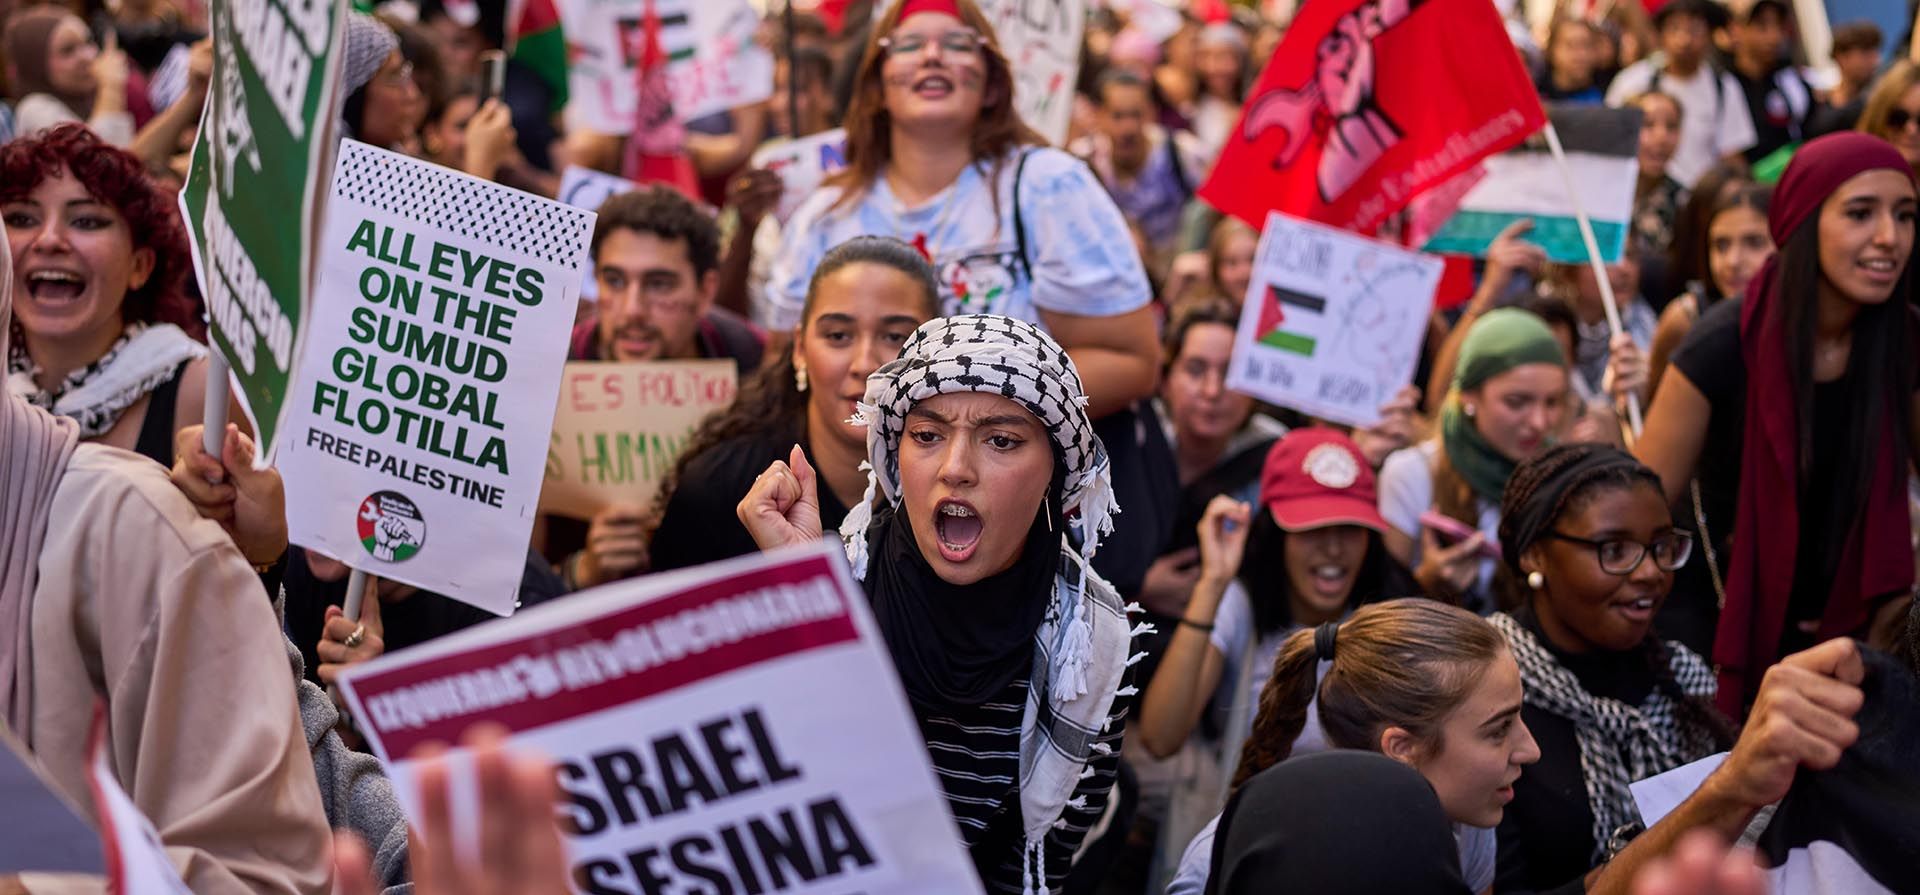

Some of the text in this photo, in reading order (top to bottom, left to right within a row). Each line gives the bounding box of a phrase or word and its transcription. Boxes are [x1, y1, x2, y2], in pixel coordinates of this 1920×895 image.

[346, 219, 545, 307] ALL EYES
[348, 307, 508, 382] SUMUD
[359, 267, 517, 344] ON THE
[312, 381, 509, 475] FLOTILLA
[332, 347, 505, 430] GLOBAL
[571, 373, 625, 413] ES
[306, 427, 363, 465] FREE
[365, 449, 505, 509] PALESTINE
